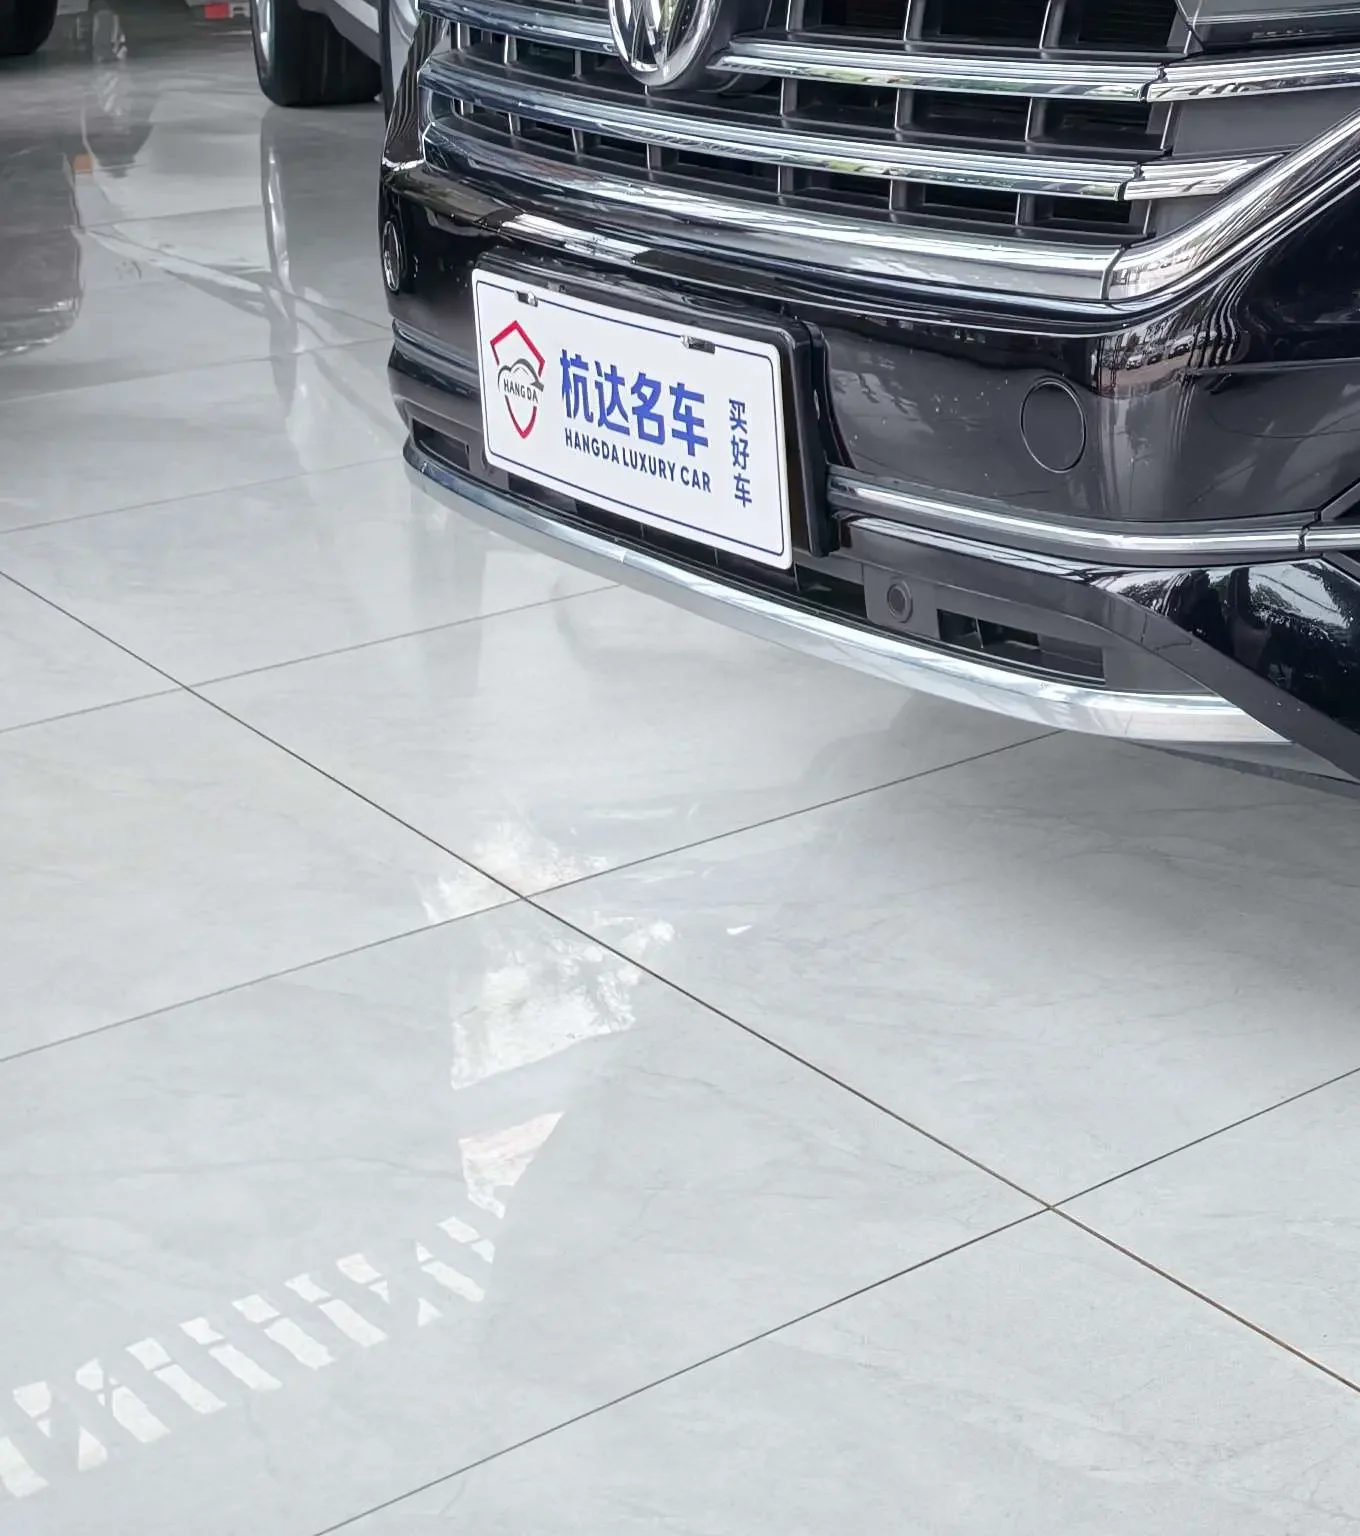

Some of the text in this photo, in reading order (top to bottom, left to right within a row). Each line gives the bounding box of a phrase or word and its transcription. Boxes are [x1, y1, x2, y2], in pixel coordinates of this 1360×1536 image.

[503, 378, 526, 399] HANG
[560, 349, 709, 457] 杭达名车
[565, 428, 712, 493] HANGDA LUXURY CAR
[728, 398, 752, 508] 买好车
